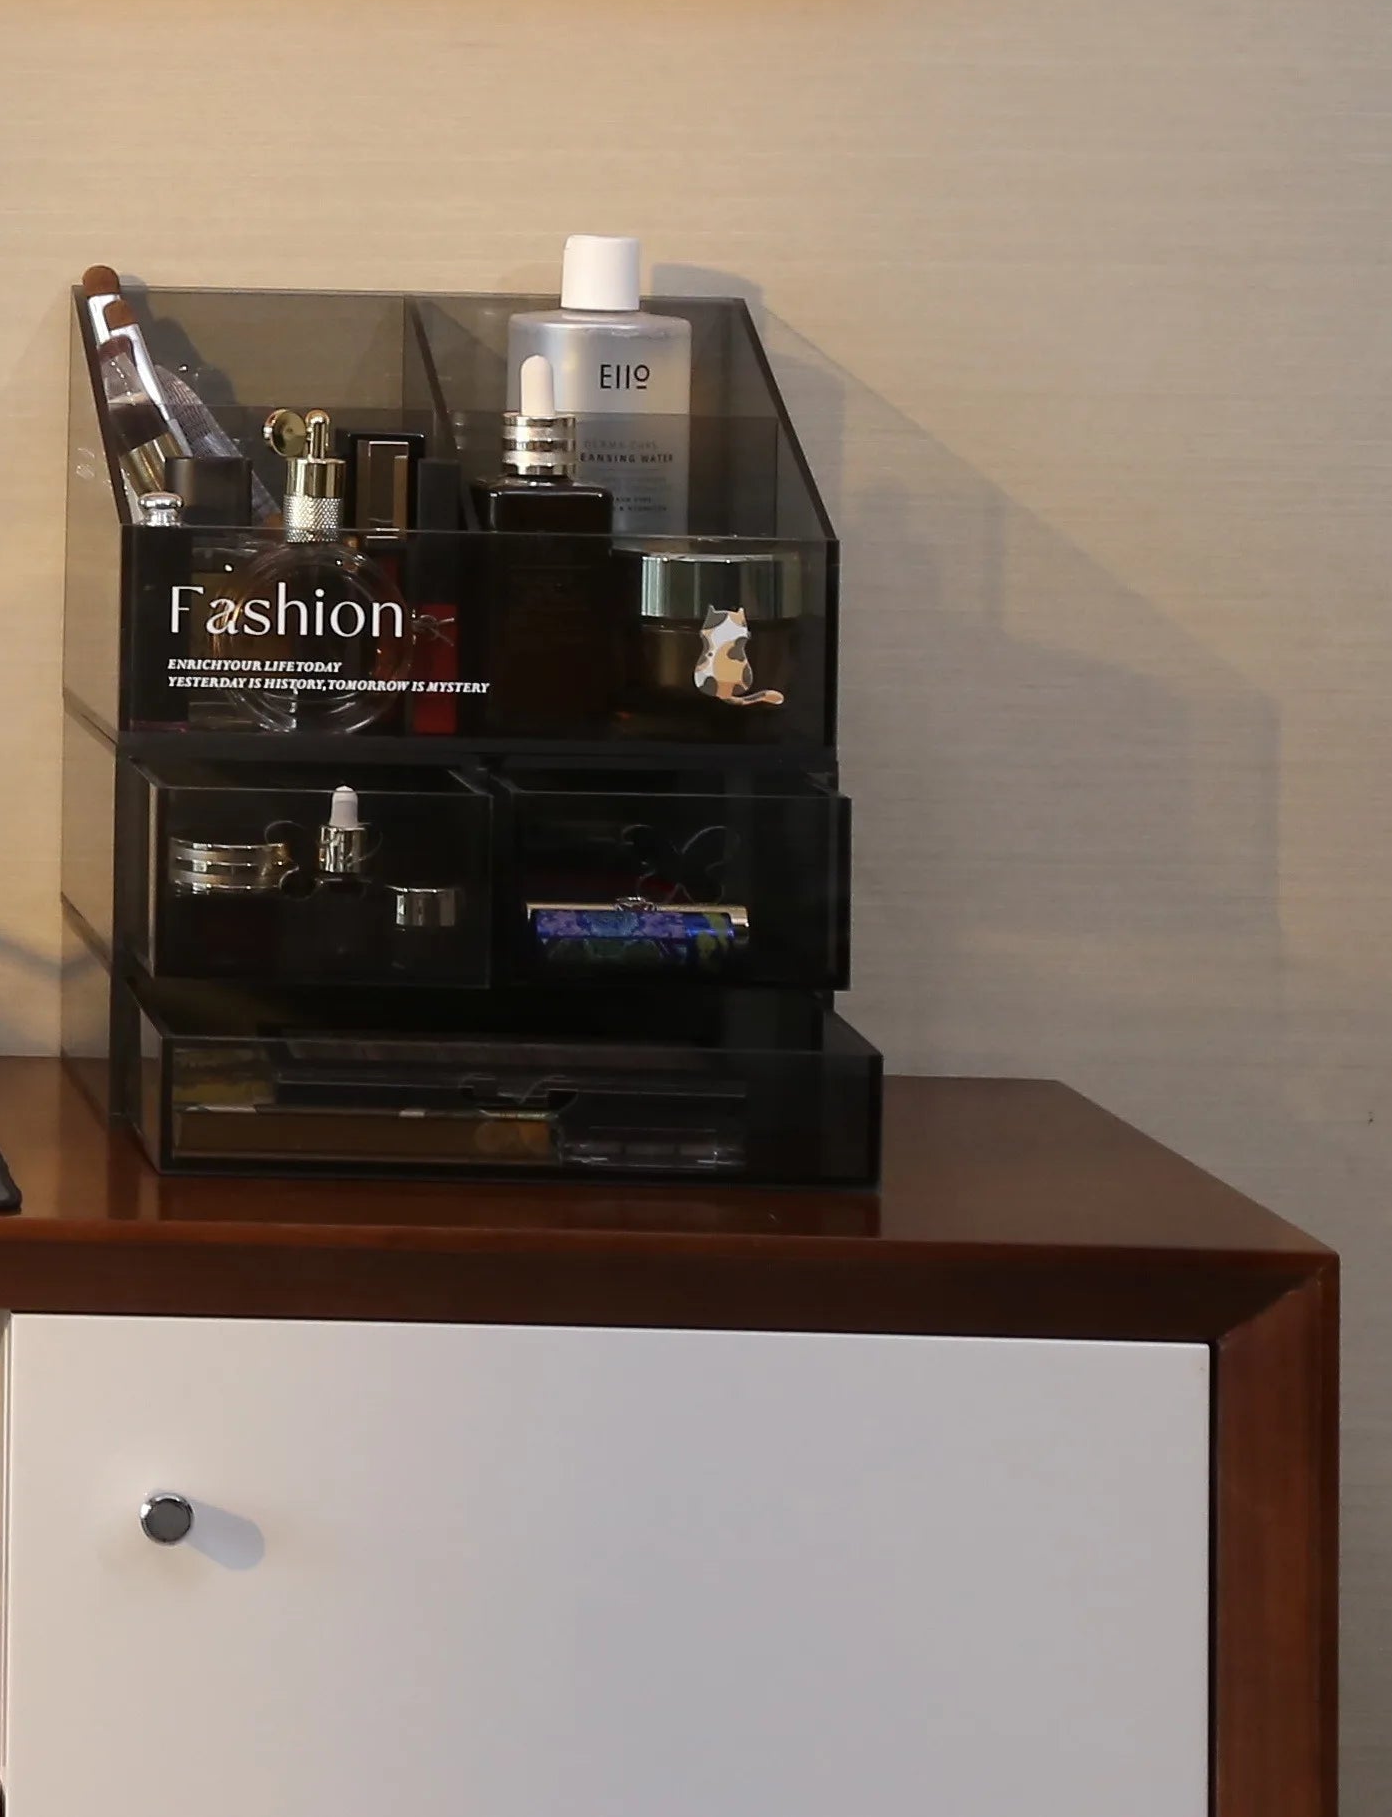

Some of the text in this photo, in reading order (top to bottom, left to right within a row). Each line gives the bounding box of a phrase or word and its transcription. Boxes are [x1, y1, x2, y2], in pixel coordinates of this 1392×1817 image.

[171, 581, 403, 637] Fashion
[168, 676, 247, 688] YESTERDAY
[248, 678, 262, 689] IS
[411, 682, 425, 693] IS
[426, 682, 490, 694] MYSTERY
